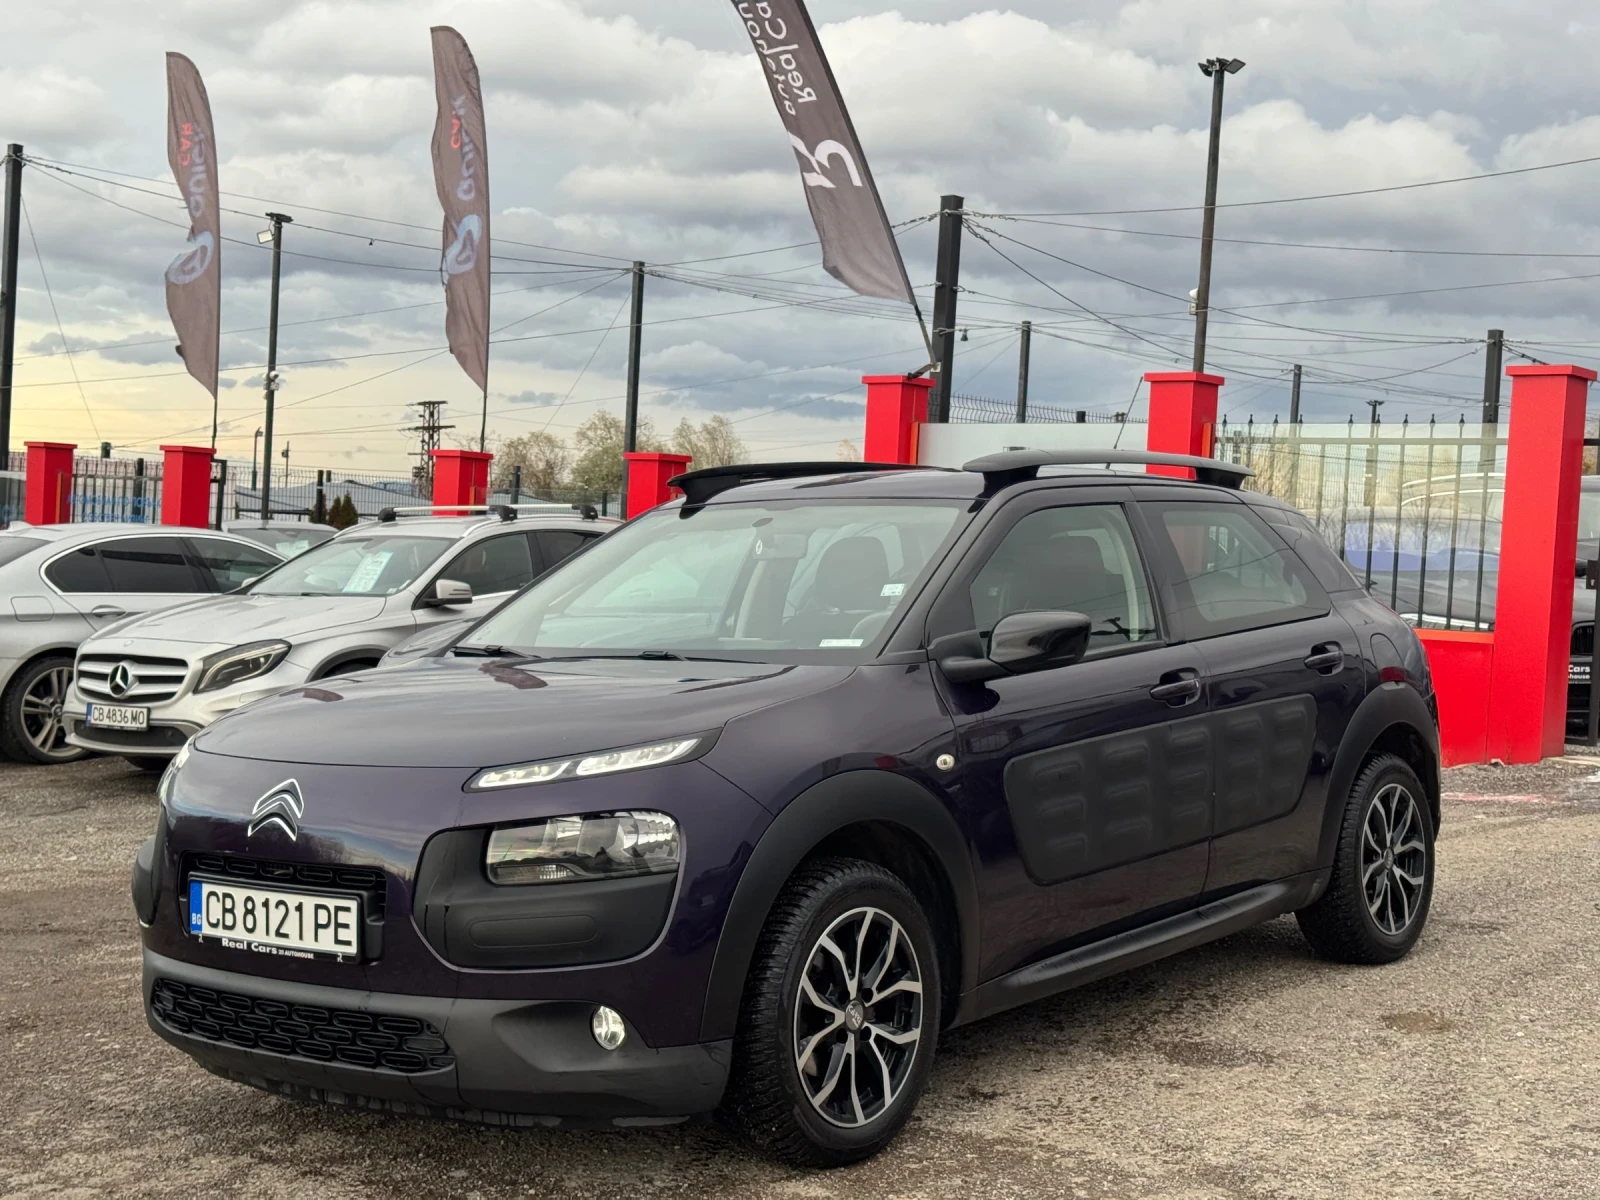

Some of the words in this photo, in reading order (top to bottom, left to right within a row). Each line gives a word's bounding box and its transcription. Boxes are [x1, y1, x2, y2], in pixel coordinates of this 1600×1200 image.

[1568, 664, 1591, 672] Cars
[191, 912, 202, 925] BG
[206, 890, 237, 931] CB
[243, 896, 304, 941] 8121
[314, 903, 353, 947] PE
[221, 938, 247, 950] Real
[250, 942, 278, 955] Cars
[284, 949, 315, 960] AUTOHOUSE
